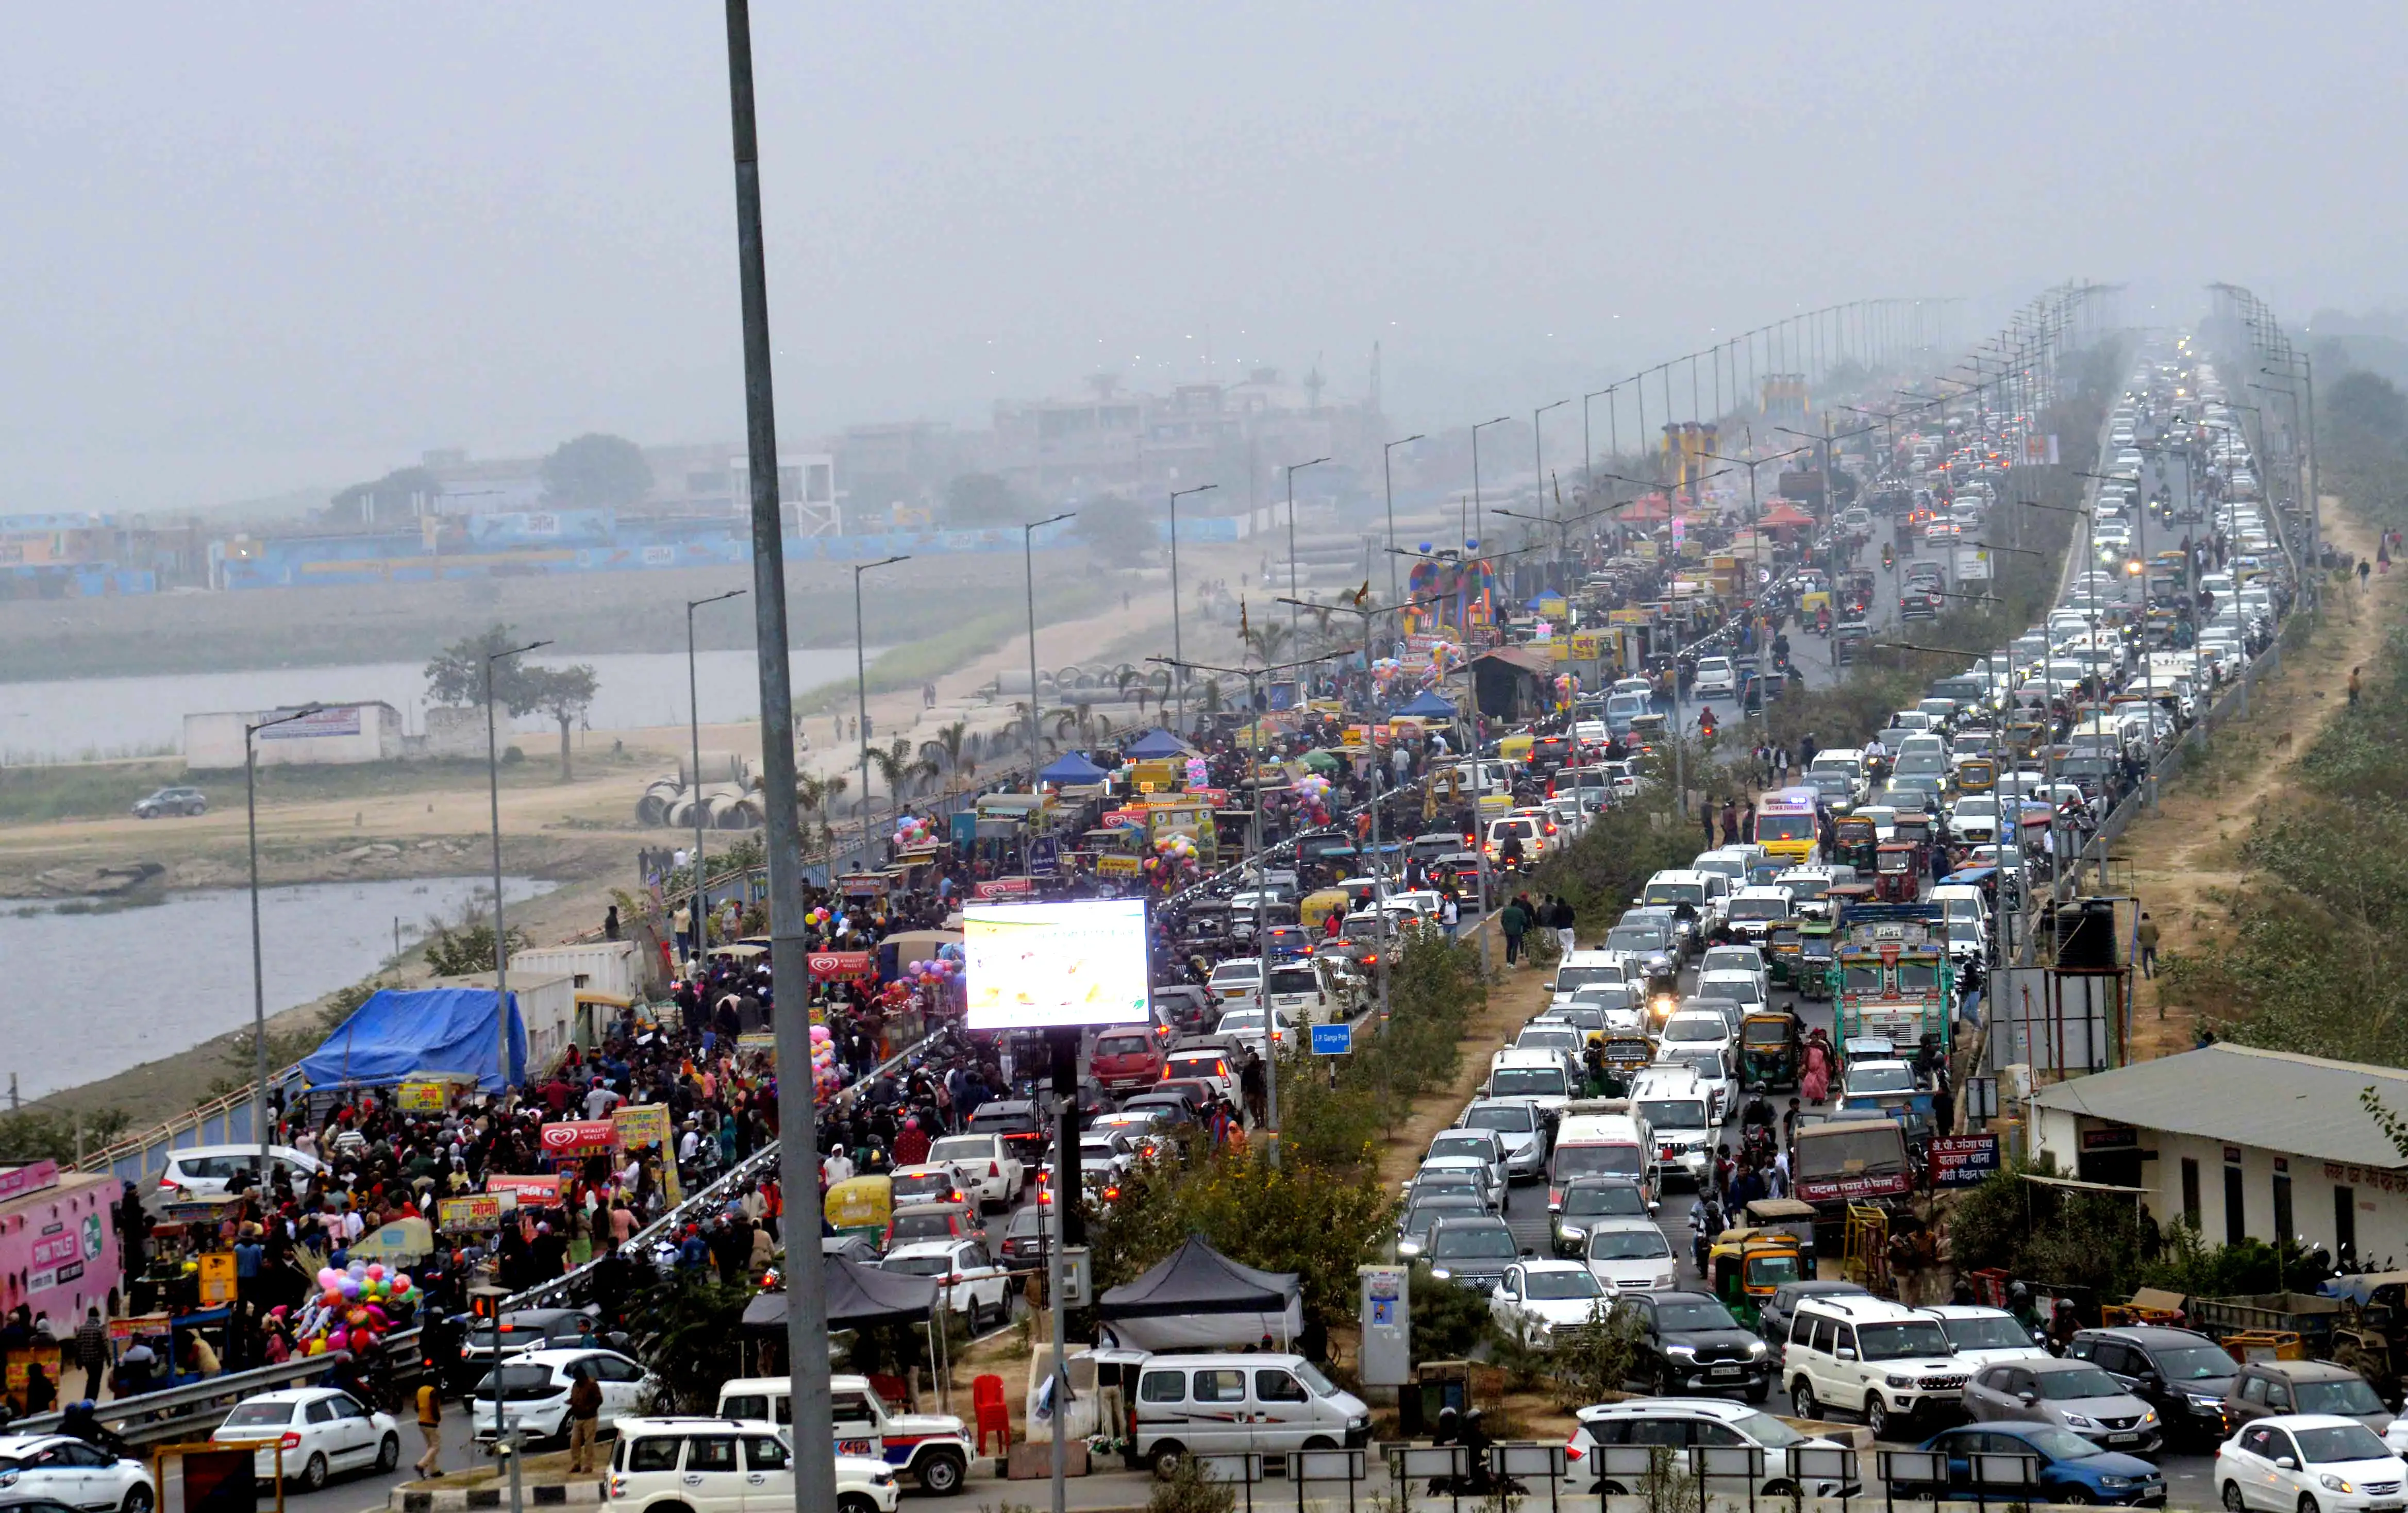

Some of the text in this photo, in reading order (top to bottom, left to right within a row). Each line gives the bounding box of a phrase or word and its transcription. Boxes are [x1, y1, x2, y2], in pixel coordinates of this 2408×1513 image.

[580, 1126, 610, 1134] KWALITY
[1956, 1138, 1977, 1149] गंगा
[1978, 1139, 1993, 1149] पथ
[1939, 1153, 1990, 1165] यातायात थाना
[1809, 1184, 1837, 1194] पटना
[471, 1201, 497, 1215] मोमो
